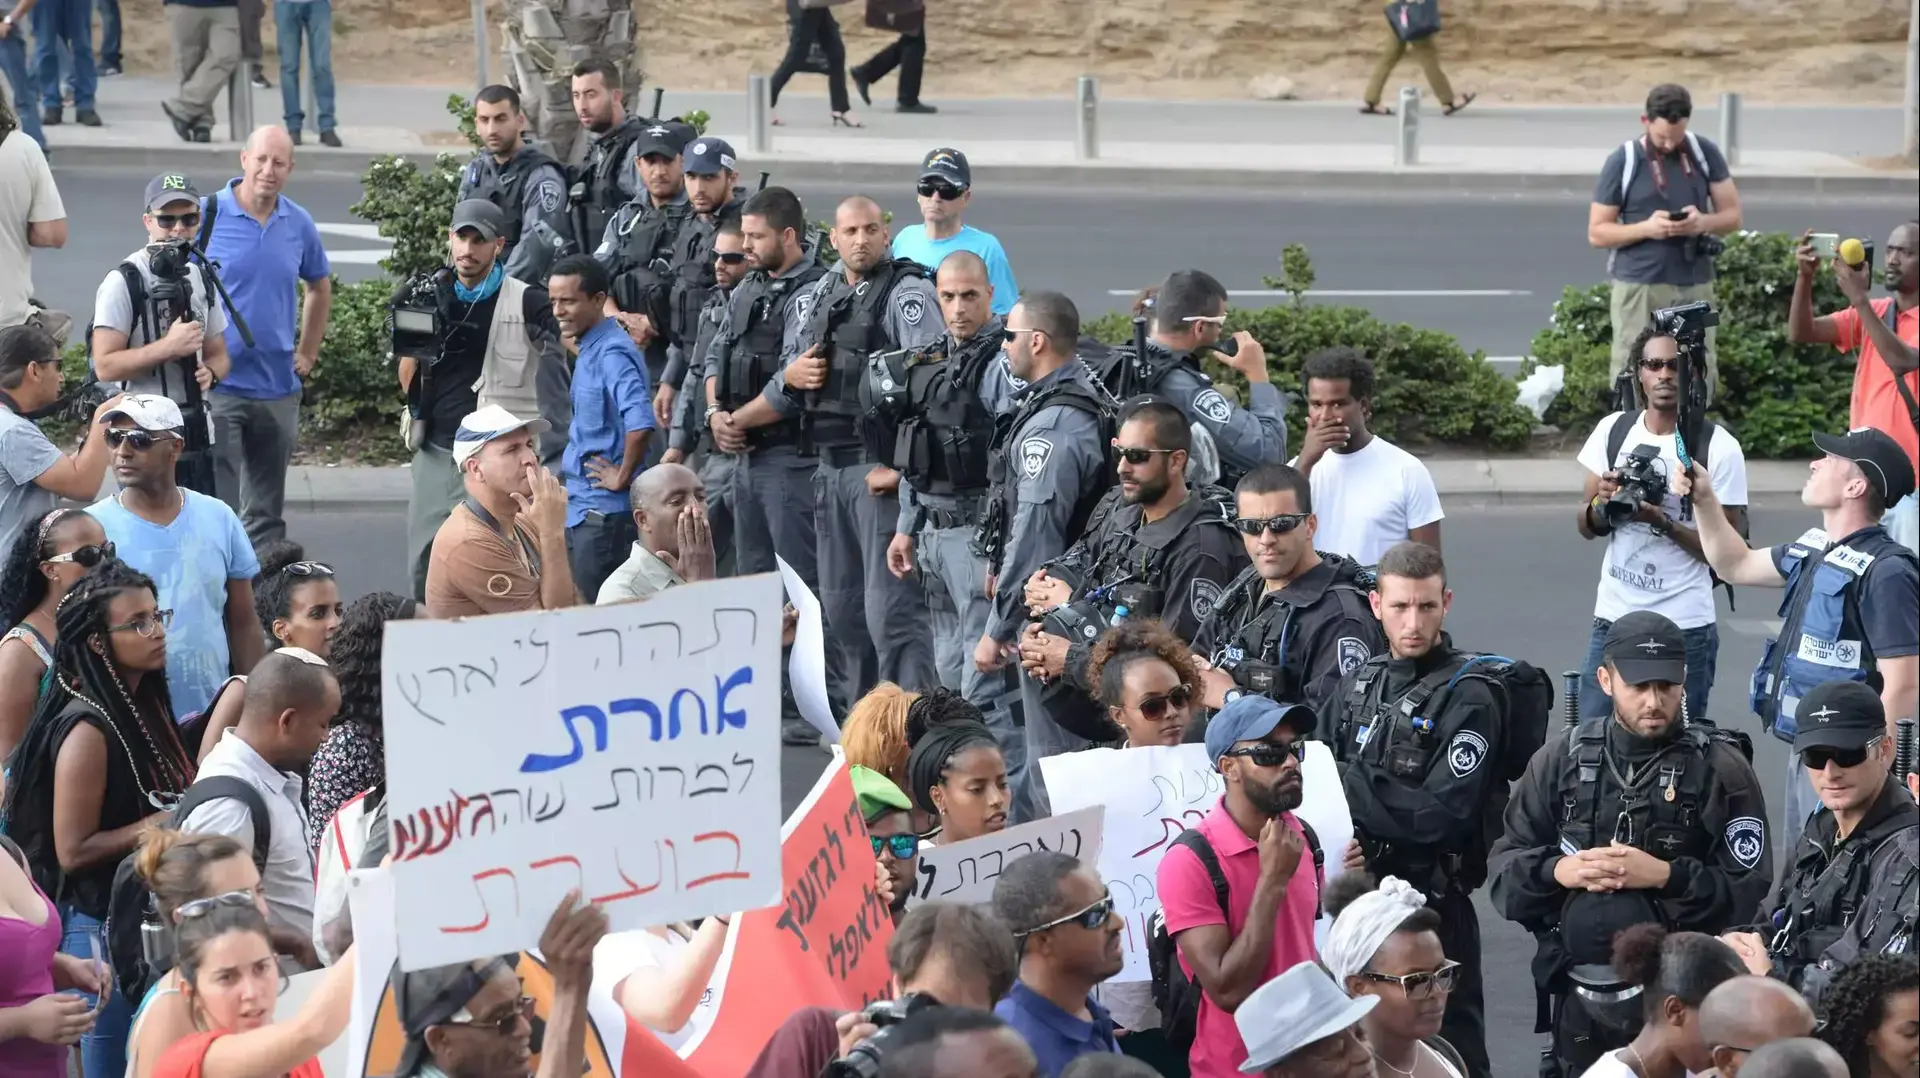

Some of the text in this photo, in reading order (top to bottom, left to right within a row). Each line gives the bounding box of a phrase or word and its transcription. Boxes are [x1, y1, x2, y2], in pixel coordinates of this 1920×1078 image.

[396, 608, 757, 725] תהיה לי ארץ
[1804, 645, 1832, 659] ישראל
[519, 666, 753, 773] אחרת
[592, 750, 754, 811] למרות
[439, 830, 751, 933] בוערת
